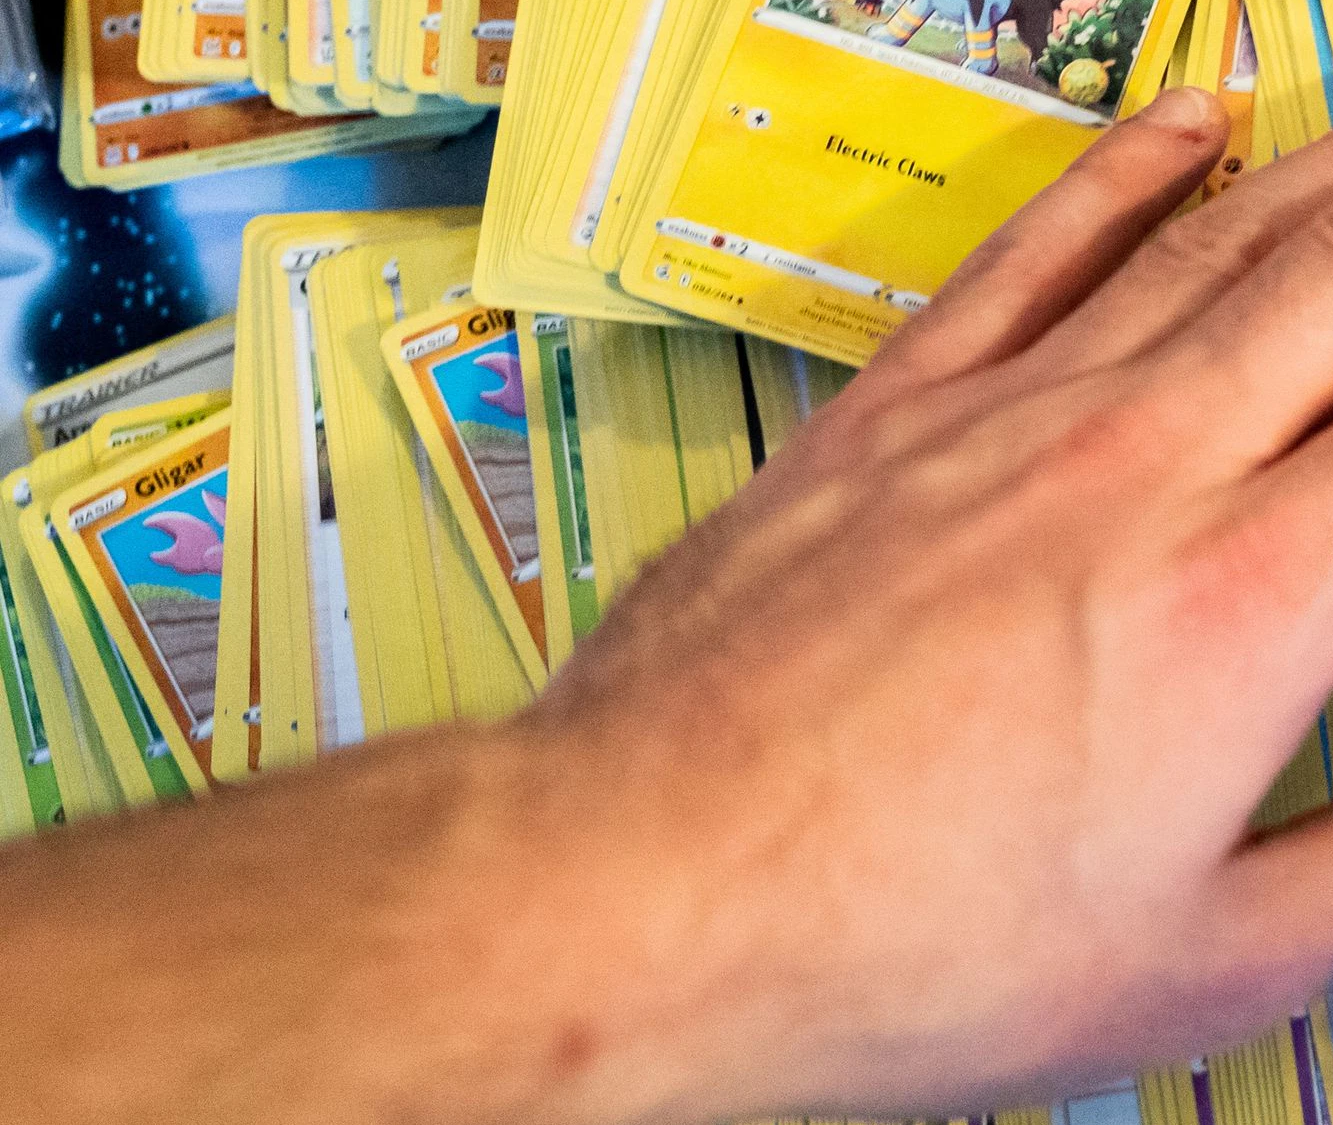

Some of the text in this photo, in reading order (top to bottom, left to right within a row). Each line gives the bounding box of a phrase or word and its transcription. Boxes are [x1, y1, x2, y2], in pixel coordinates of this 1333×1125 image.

[826, 134, 947, 188] Electric Claws
[402, 330, 456, 363] BASIC
[73, 451, 208, 529] BASIC Gligar
